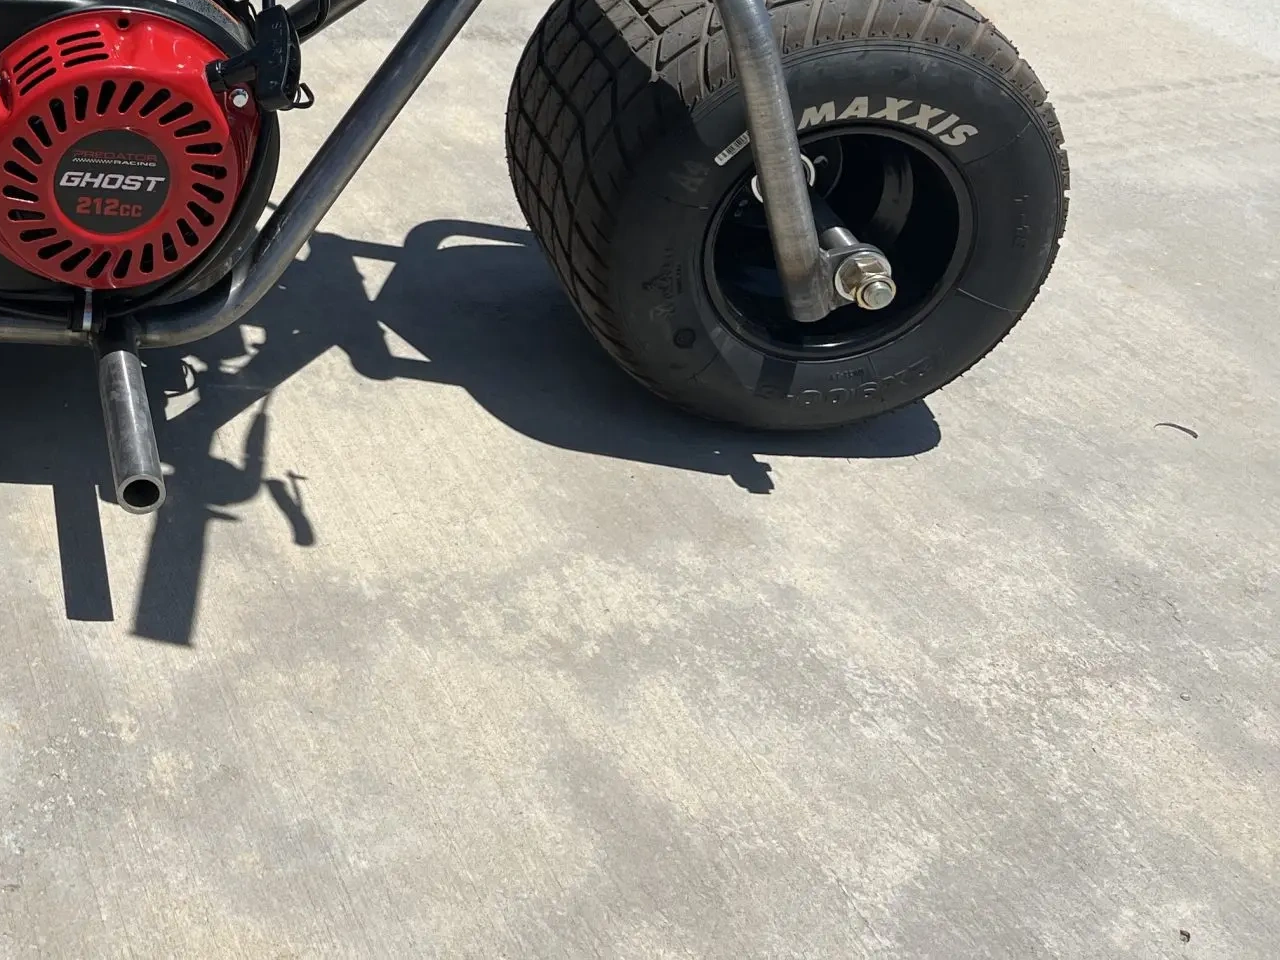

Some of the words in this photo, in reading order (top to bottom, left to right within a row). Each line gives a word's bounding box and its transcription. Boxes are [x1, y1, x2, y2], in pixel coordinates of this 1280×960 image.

[797, 96, 978, 146] MAXXIS
[73, 150, 157, 161] PREDATOR
[60, 171, 165, 192] GHOST
